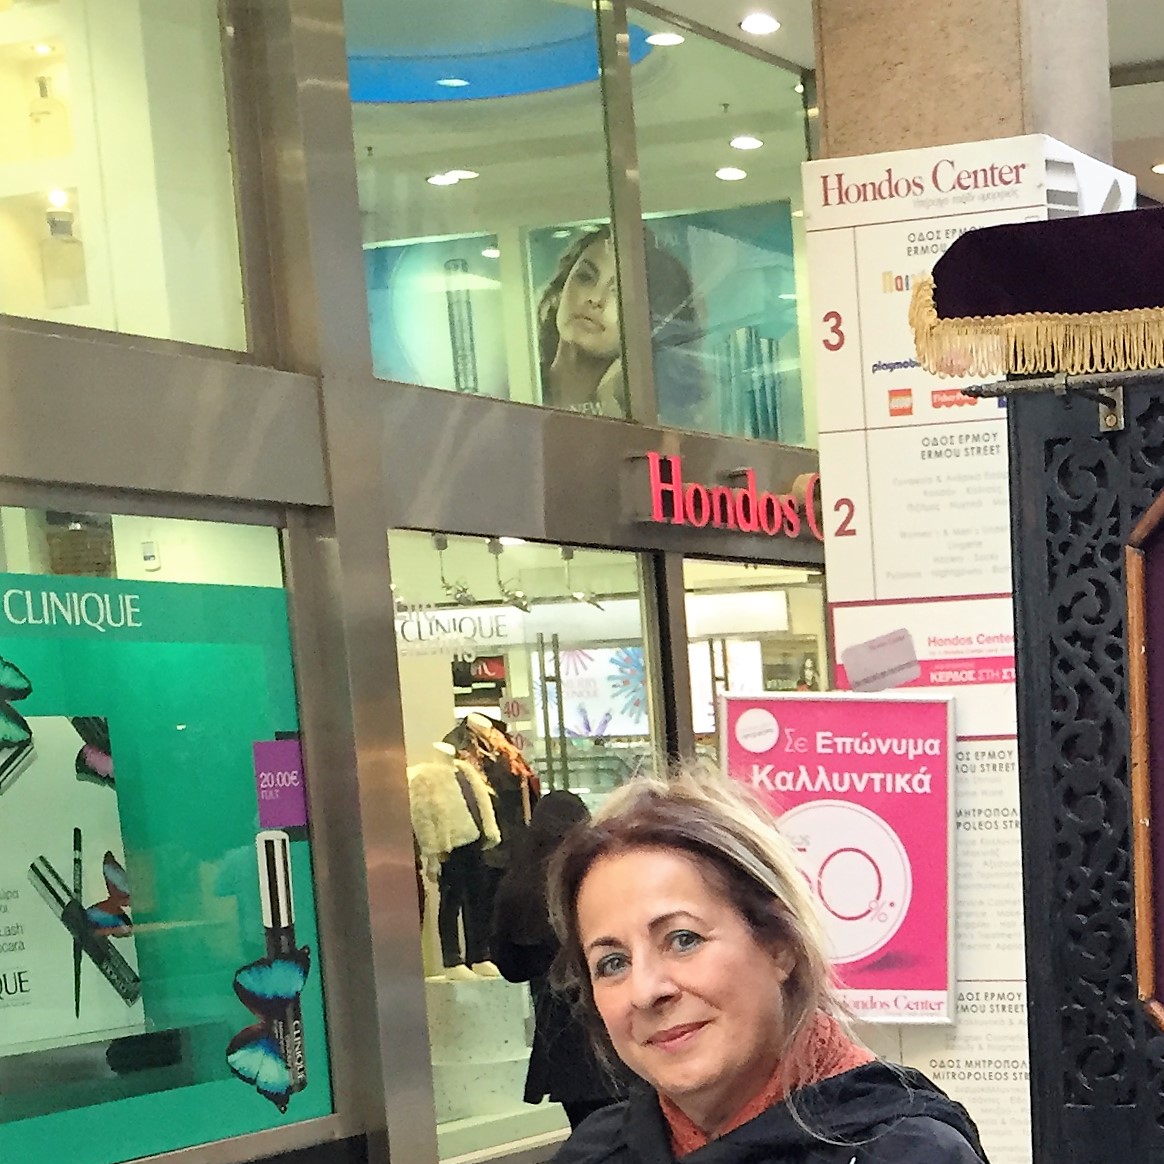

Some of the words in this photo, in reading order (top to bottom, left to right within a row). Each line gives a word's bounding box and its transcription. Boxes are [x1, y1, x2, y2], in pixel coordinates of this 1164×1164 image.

[820, 168, 925, 208] Hondos
[931, 159, 1027, 194] Center
[907, 230, 942, 243] ΟΔΟΣ
[821, 311, 845, 351] 3
[921, 435, 955, 447] ΟΔΟΣ
[958, 432, 999, 444] ΕΡΜΟΥ
[920, 448, 960, 460] ERMOU
[964, 445, 1001, 457] STREET
[647, 451, 801, 538] Hondos
[833, 498, 857, 537] 2
[3, 589, 142, 632] CLINIQUE
[400, 614, 508, 643] CLINIQUE
[927, 635, 974, 647] Hondos
[783, 728, 809, 753] Σε
[815, 732, 941, 761] Επώνυμα
[974, 750, 1014, 761] ΕΡΜΟΥ
[979, 762, 1016, 773] STREET
[259, 770, 300, 788] 20.00€
[751, 764, 932, 794] Καλλυντικά
[894, 994, 944, 1012] Center
[984, 991, 1022, 1002] ΕΡΜΟΥ
[989, 1003, 1025, 1014] STREET
[929, 1060, 961, 1070] ΟΔΟΣ
[932, 1071, 1009, 1082] MITROPOLEOS
